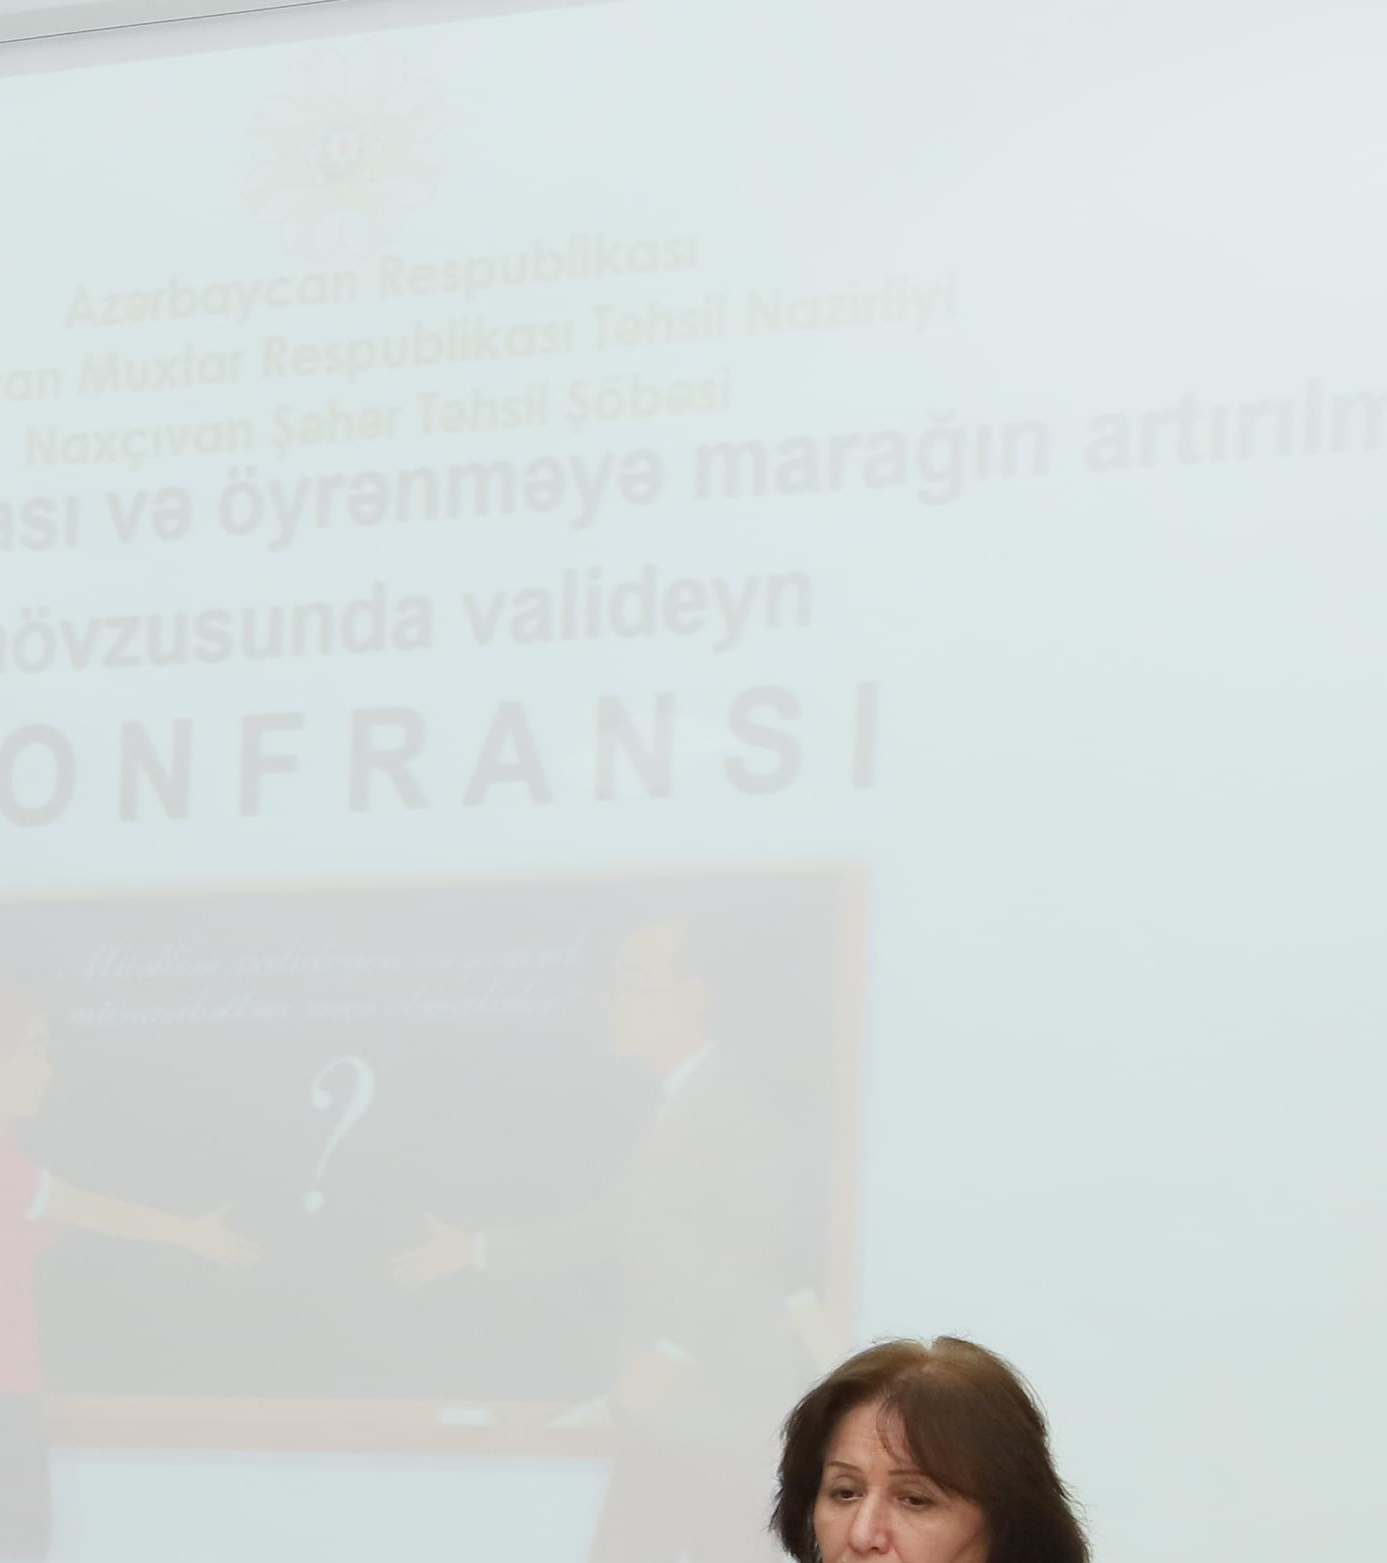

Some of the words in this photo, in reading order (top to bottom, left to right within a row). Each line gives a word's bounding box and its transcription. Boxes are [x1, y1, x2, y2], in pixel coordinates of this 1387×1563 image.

[63, 269, 358, 331] Azərbaycan
[377, 229, 698, 302] Respublikası
[261, 316, 574, 382] Respublikası
[591, 292, 726, 350] Təhsil
[25, 417, 254, 469] Naxçıvan
[269, 399, 403, 461] Şəhər
[416, 381, 548, 437] Təhsil
[567, 367, 734, 433] Şöbəsi
[105, 484, 193, 546] və
[218, 445, 665, 554] öyrənməyə
[692, 406, 1053, 508] marağın
[461, 560, 817, 656] valideyn
